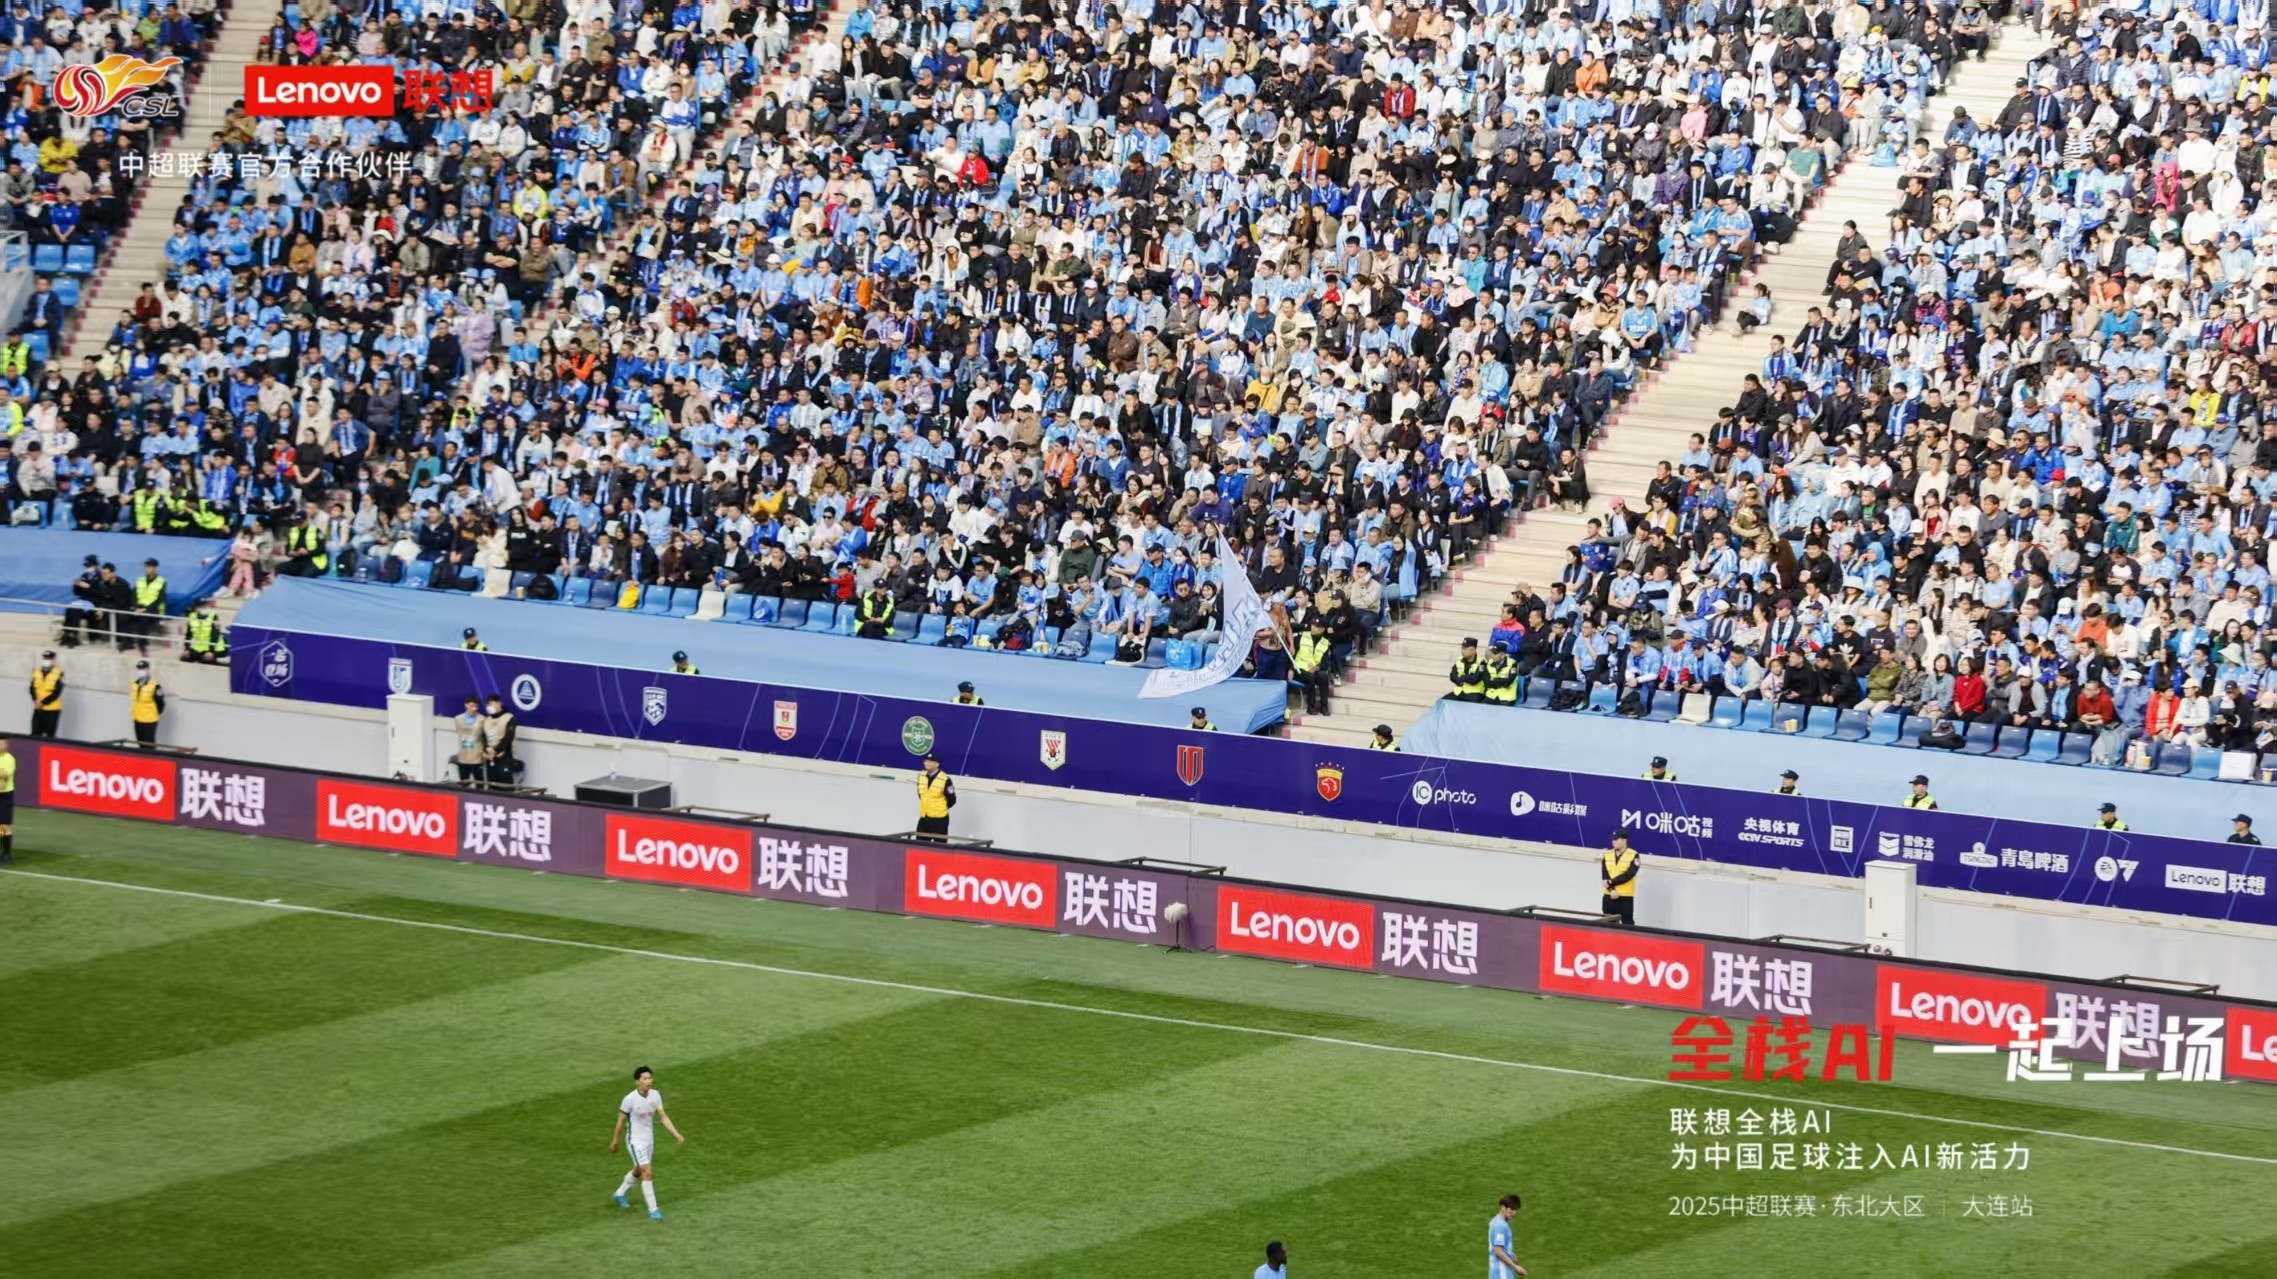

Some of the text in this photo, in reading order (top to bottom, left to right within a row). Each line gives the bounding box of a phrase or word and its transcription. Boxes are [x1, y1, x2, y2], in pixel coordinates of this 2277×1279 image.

[51, 759, 266, 827] Lenovo 联想
[1434, 786, 1477, 805] photo
[1743, 816, 1800, 836] 央视体育
[328, 794, 552, 862] Lenovo 联想
[2001, 848, 2069, 873] 青岛啤酒
[617, 829, 849, 899] Lenovo 联想
[2171, 869, 2267, 896] Lenovo 联想
[918, 864, 1158, 934] Lenovo 联想
[1230, 901, 1479, 975] Lenovo 联想
[1553, 941, 1813, 1016] Lenovo 联想
[1891, 981, 2032, 1032] Lenovo
